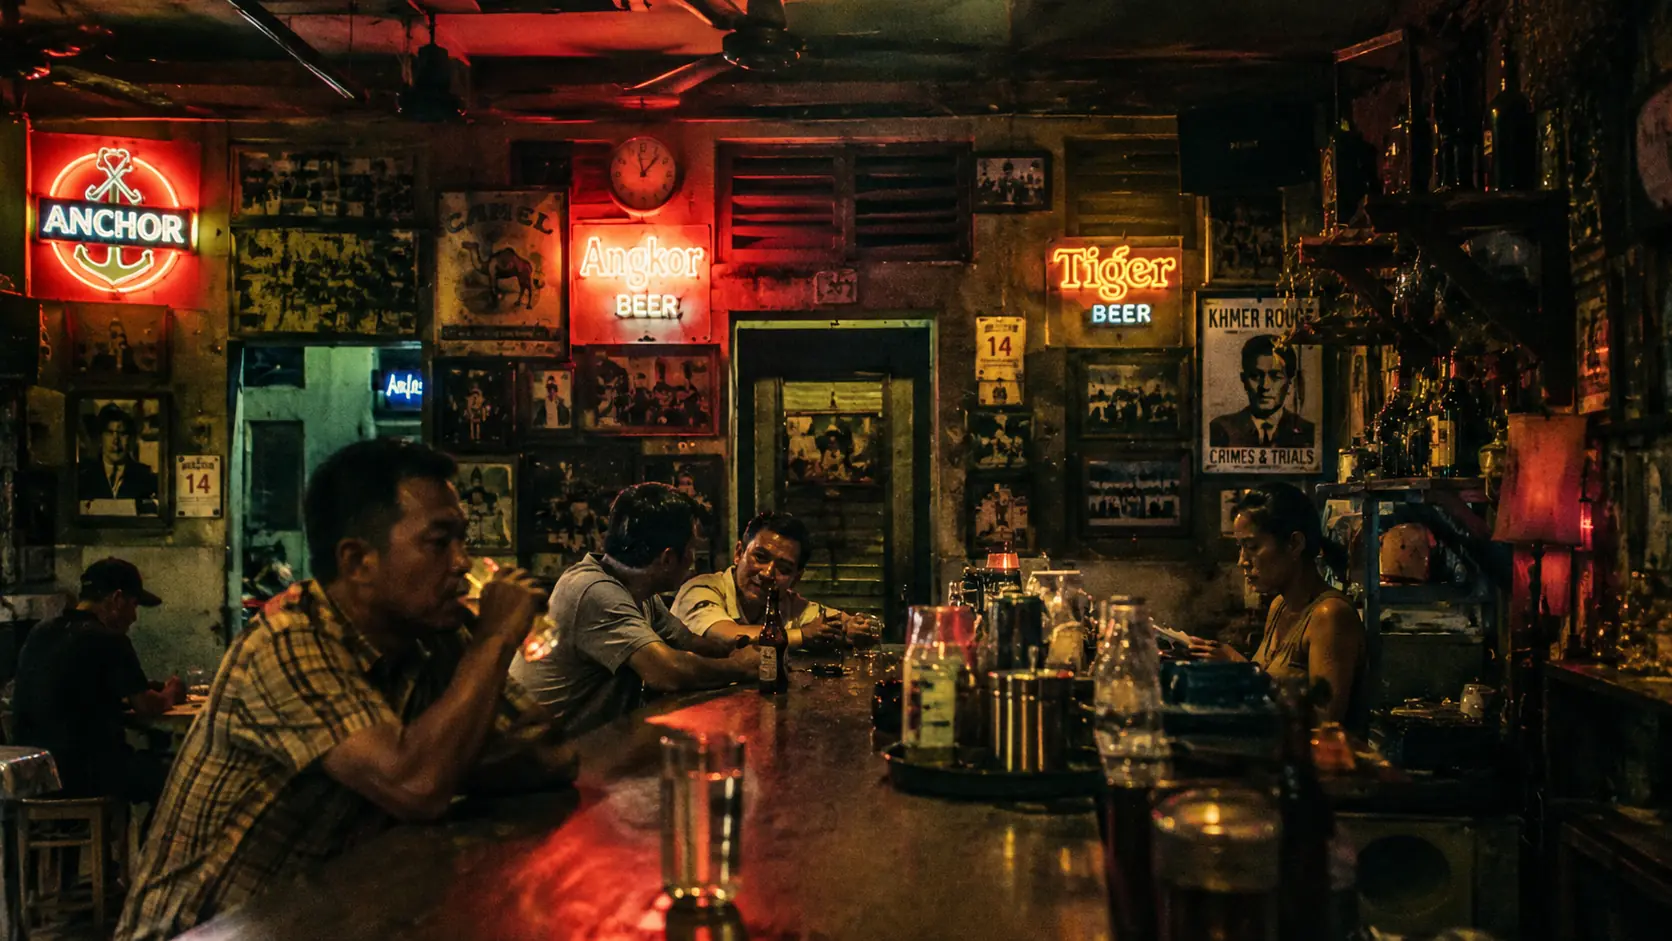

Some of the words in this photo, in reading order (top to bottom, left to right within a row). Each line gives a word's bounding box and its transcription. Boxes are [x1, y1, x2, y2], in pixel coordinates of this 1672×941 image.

[43, 204, 185, 243] ANCHOR
[446, 203, 553, 234] CAMEL
[579, 236, 704, 290] Angkor
[1054, 245, 1176, 300] Tiger
[616, 294, 678, 318] BEER
[1092, 303, 1151, 323] BEER
[1208, 307, 1260, 329] KHMER
[987, 335, 1012, 357] 14
[1209, 449, 1255, 465] CRIMES
[1259, 449, 1267, 464] &
[1271, 449, 1314, 465] TRIALS
[186, 473, 211, 494] 14
